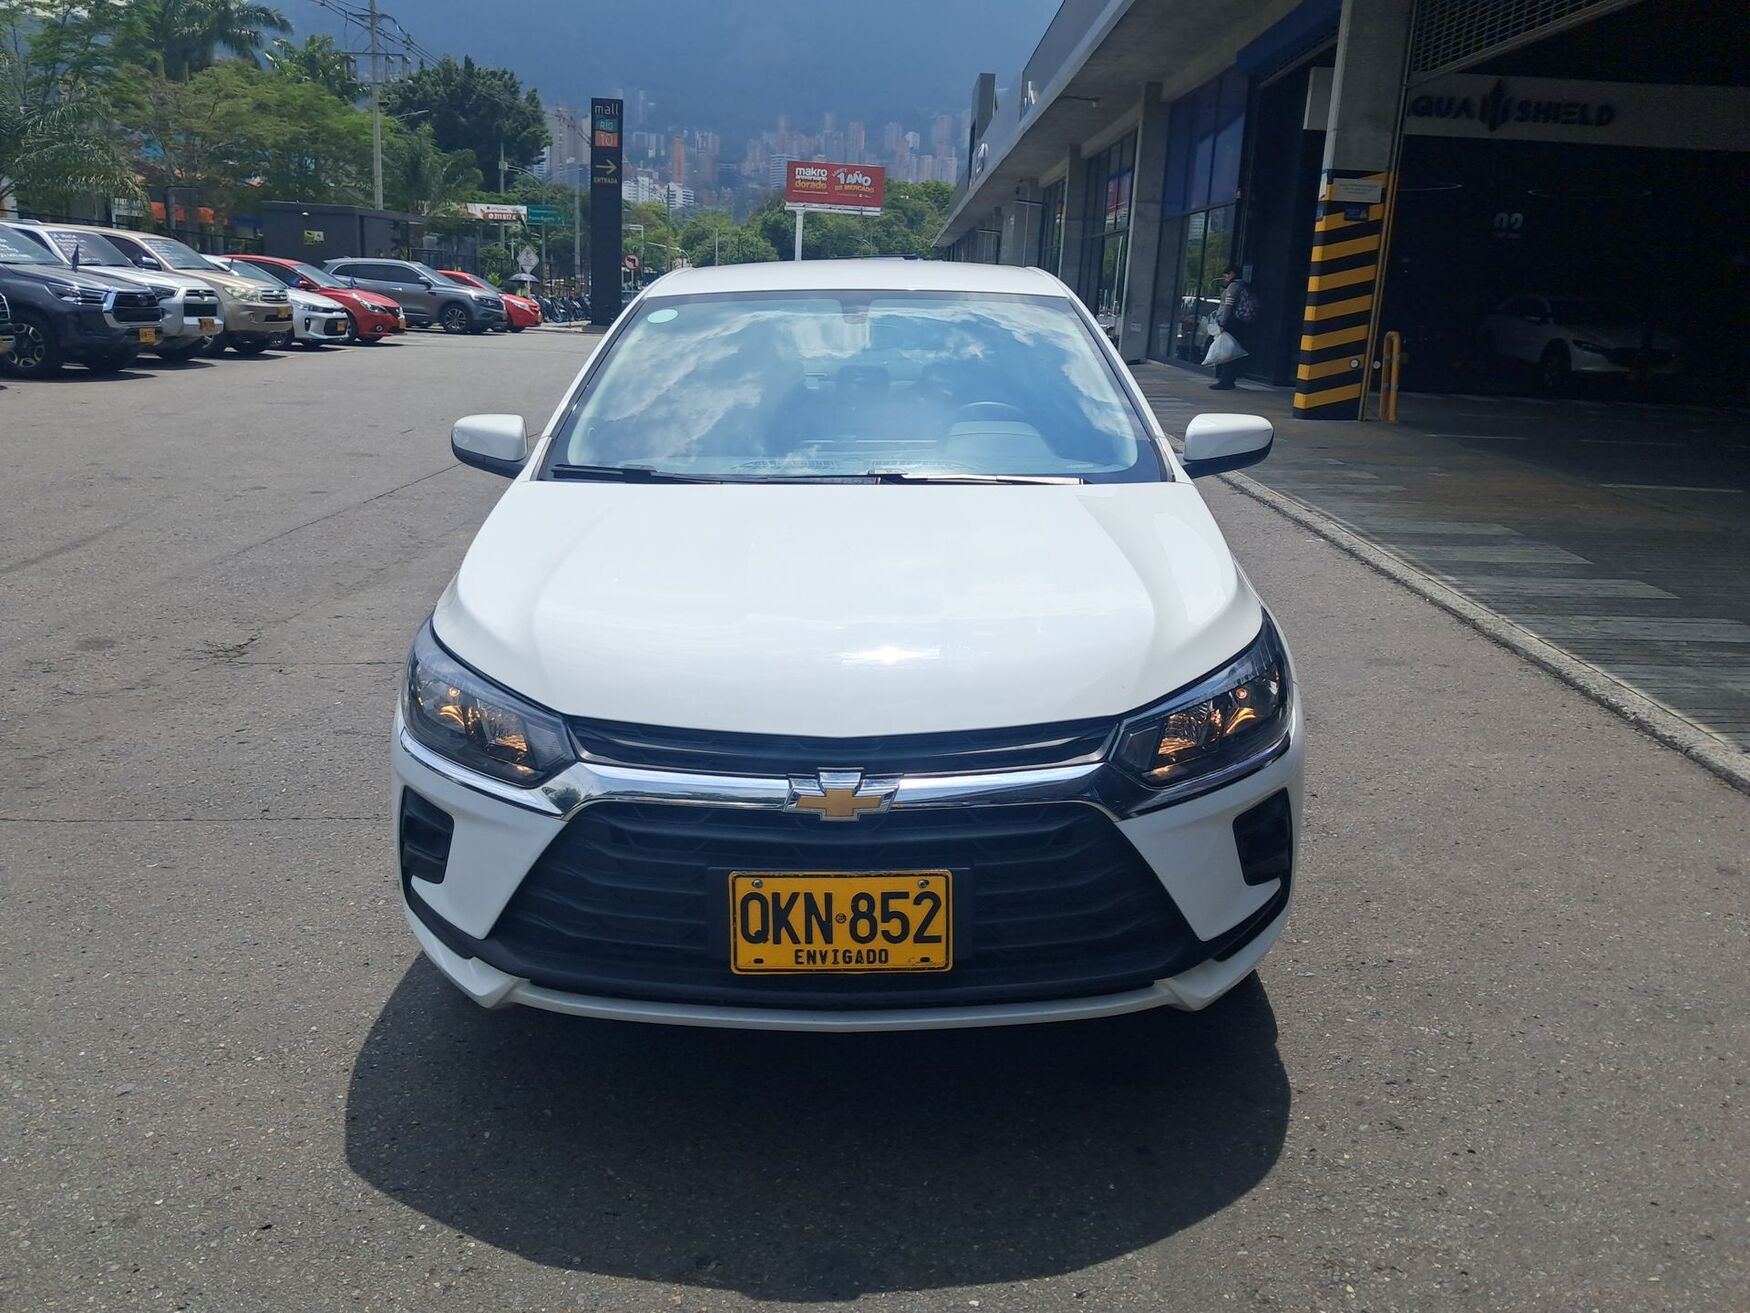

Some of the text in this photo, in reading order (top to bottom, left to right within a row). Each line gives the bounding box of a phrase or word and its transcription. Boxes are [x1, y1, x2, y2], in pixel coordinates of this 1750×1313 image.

[594, 103, 619, 115] mall
[1407, 95, 1615, 127] QUA SHIELD
[599, 133, 614, 146] 10
[795, 167, 828, 177] makro
[837, 172, 845, 185] 1
[846, 171, 872, 186] AÑO
[795, 179, 828, 189] dorado
[740, 891, 943, 945] QKN 852
[794, 948, 889, 965] ENVIGADO
